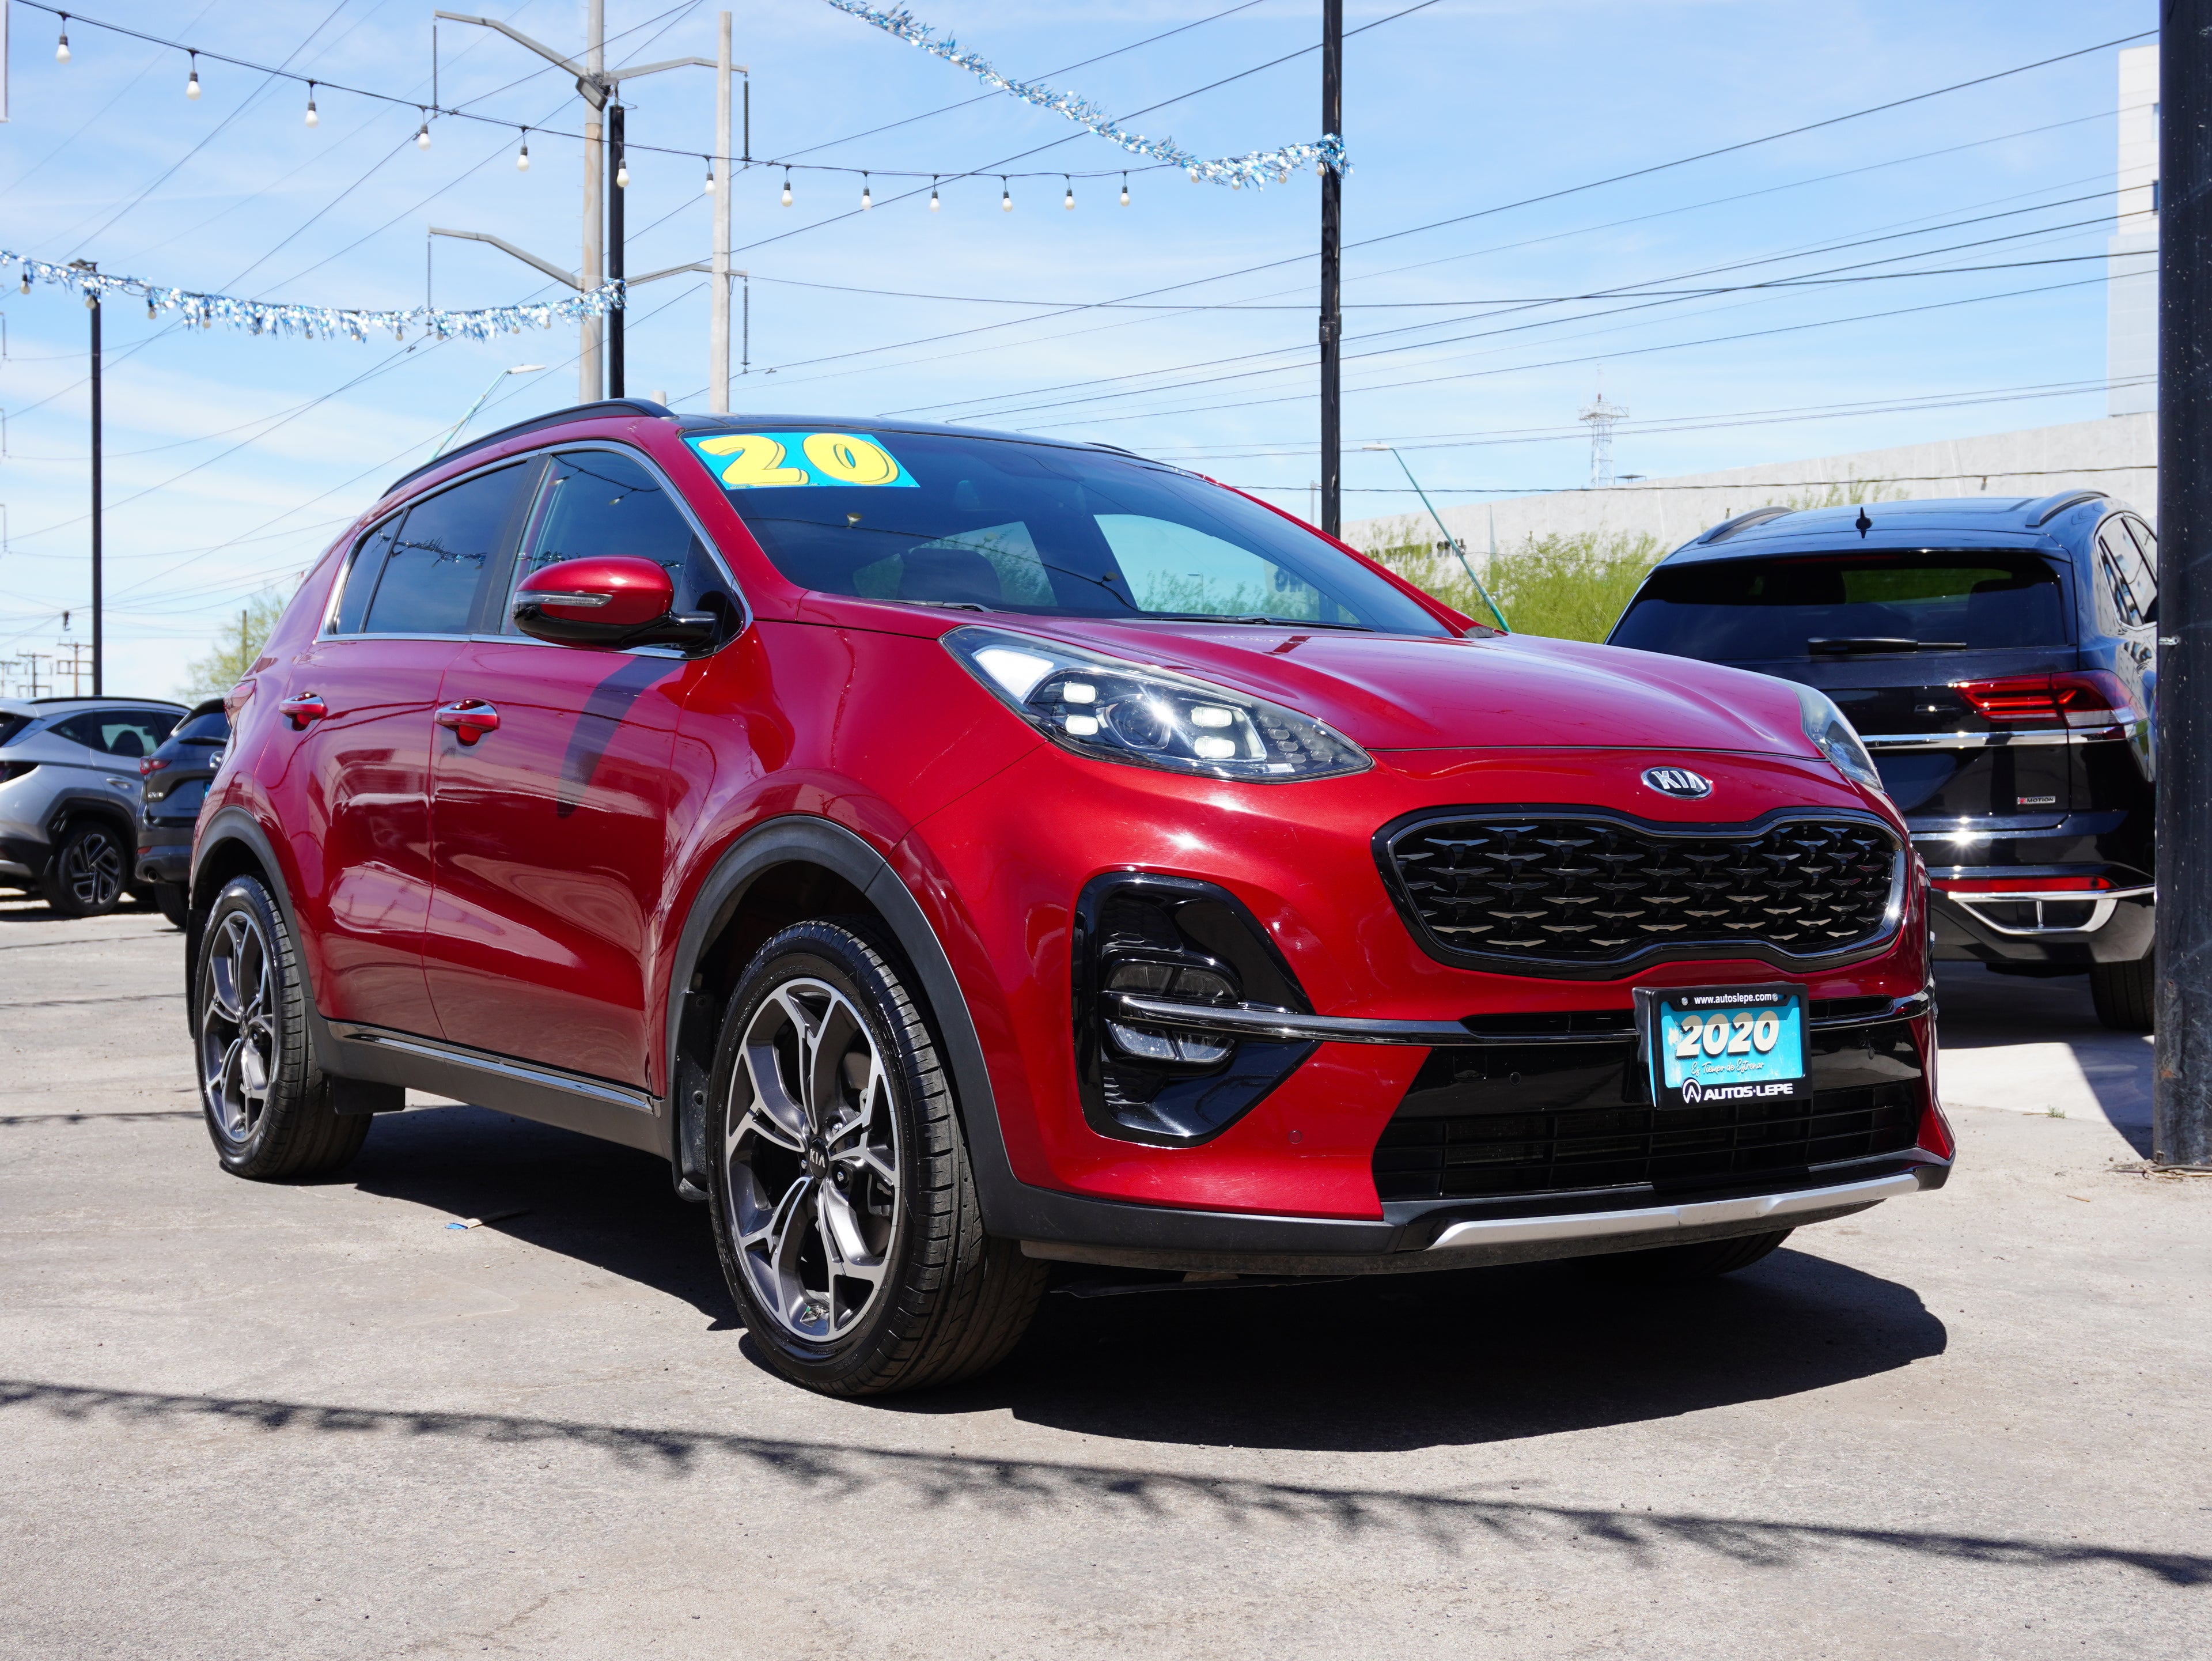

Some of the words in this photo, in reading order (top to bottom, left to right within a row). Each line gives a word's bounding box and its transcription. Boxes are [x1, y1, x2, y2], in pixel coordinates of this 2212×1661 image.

[697, 433, 900, 486] 20
[1652, 770, 1706, 789] KIA
[1694, 993, 1772, 1004] www.autoslepe.com
[1676, 1010, 1779, 1058] 2020
[1691, 1061, 1700, 1076] Es
[1702, 1061, 1725, 1074] Tiempo
[1726, 1061, 1736, 1072] de
[1736, 1058, 1764, 1073] Estrenar
[810, 1148, 826, 1168] KIA
